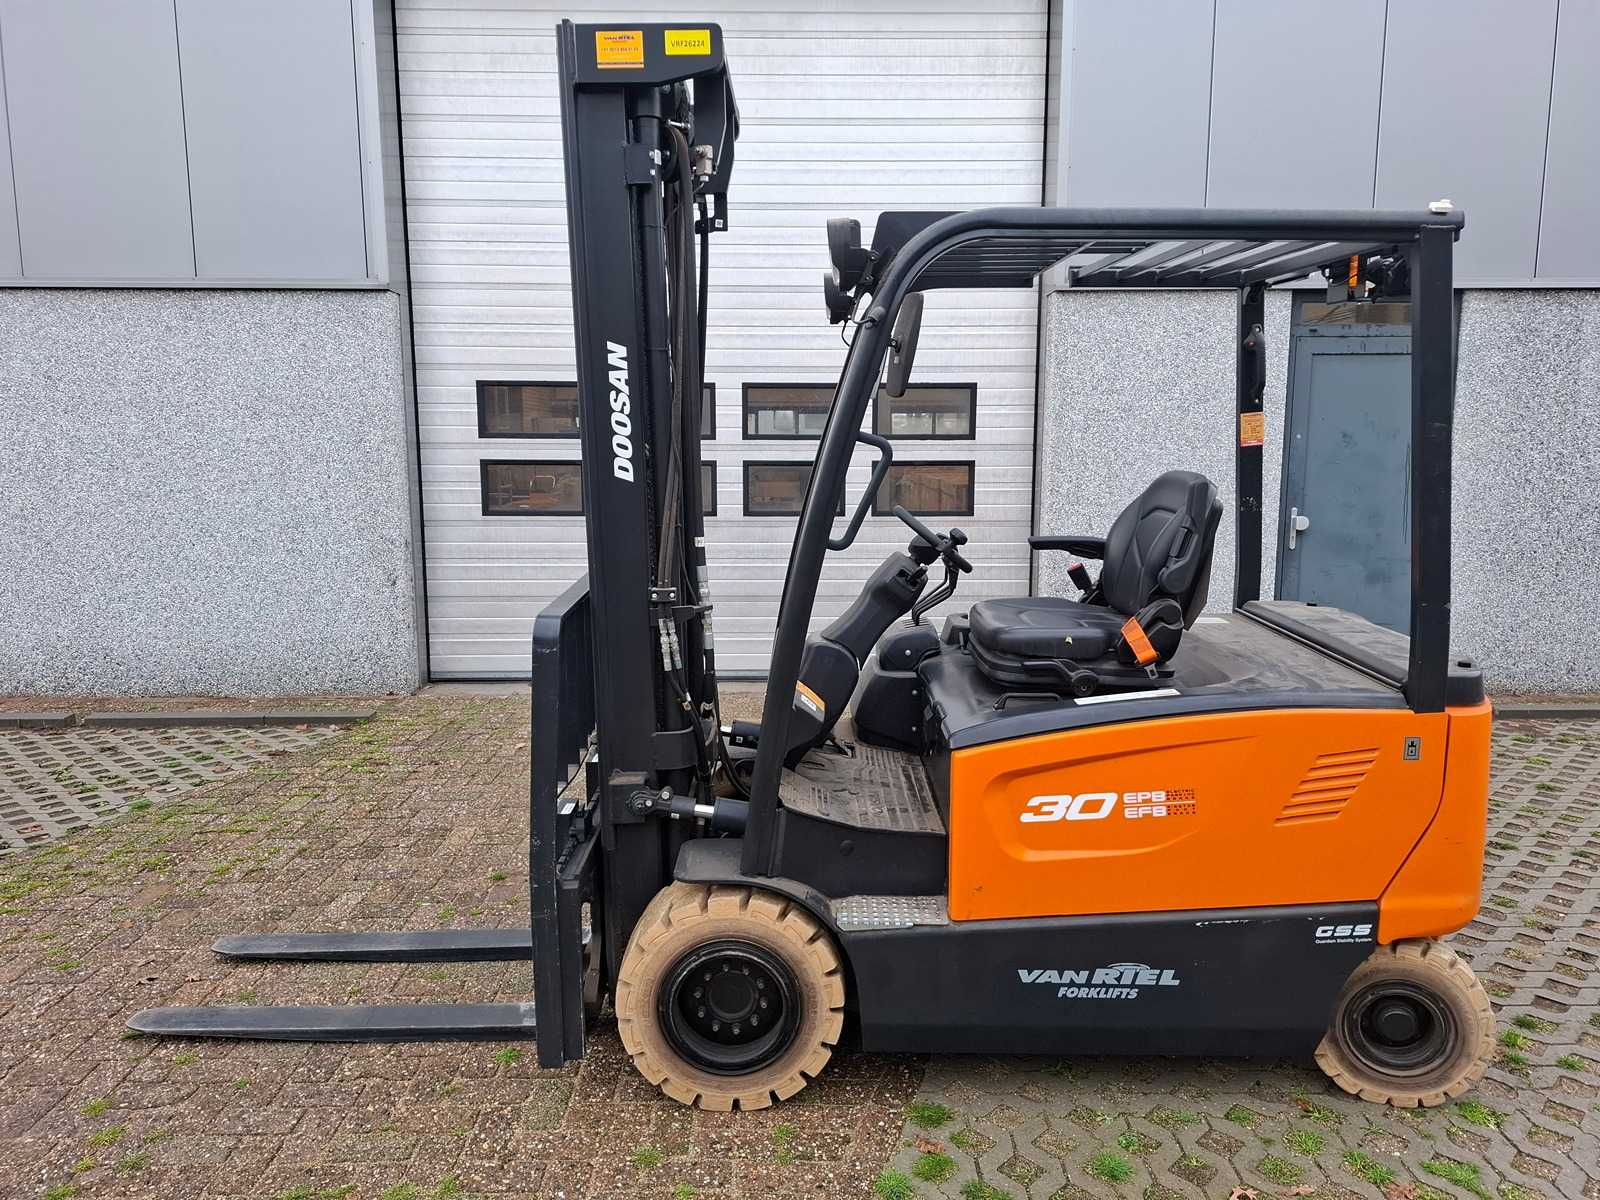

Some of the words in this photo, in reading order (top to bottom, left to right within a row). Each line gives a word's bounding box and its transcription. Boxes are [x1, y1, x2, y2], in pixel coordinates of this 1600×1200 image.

[606, 341, 635, 483] DOOSAN
[1123, 790, 1166, 804] EPB
[1020, 792, 1118, 823] 30
[1124, 805, 1167, 819] EFB
[1315, 924, 1373, 937] GSS
[1017, 969, 1089, 984] VAN
[1090, 967, 1181, 986] RIEL
[1057, 986, 1139, 999] FORKLIFTS
